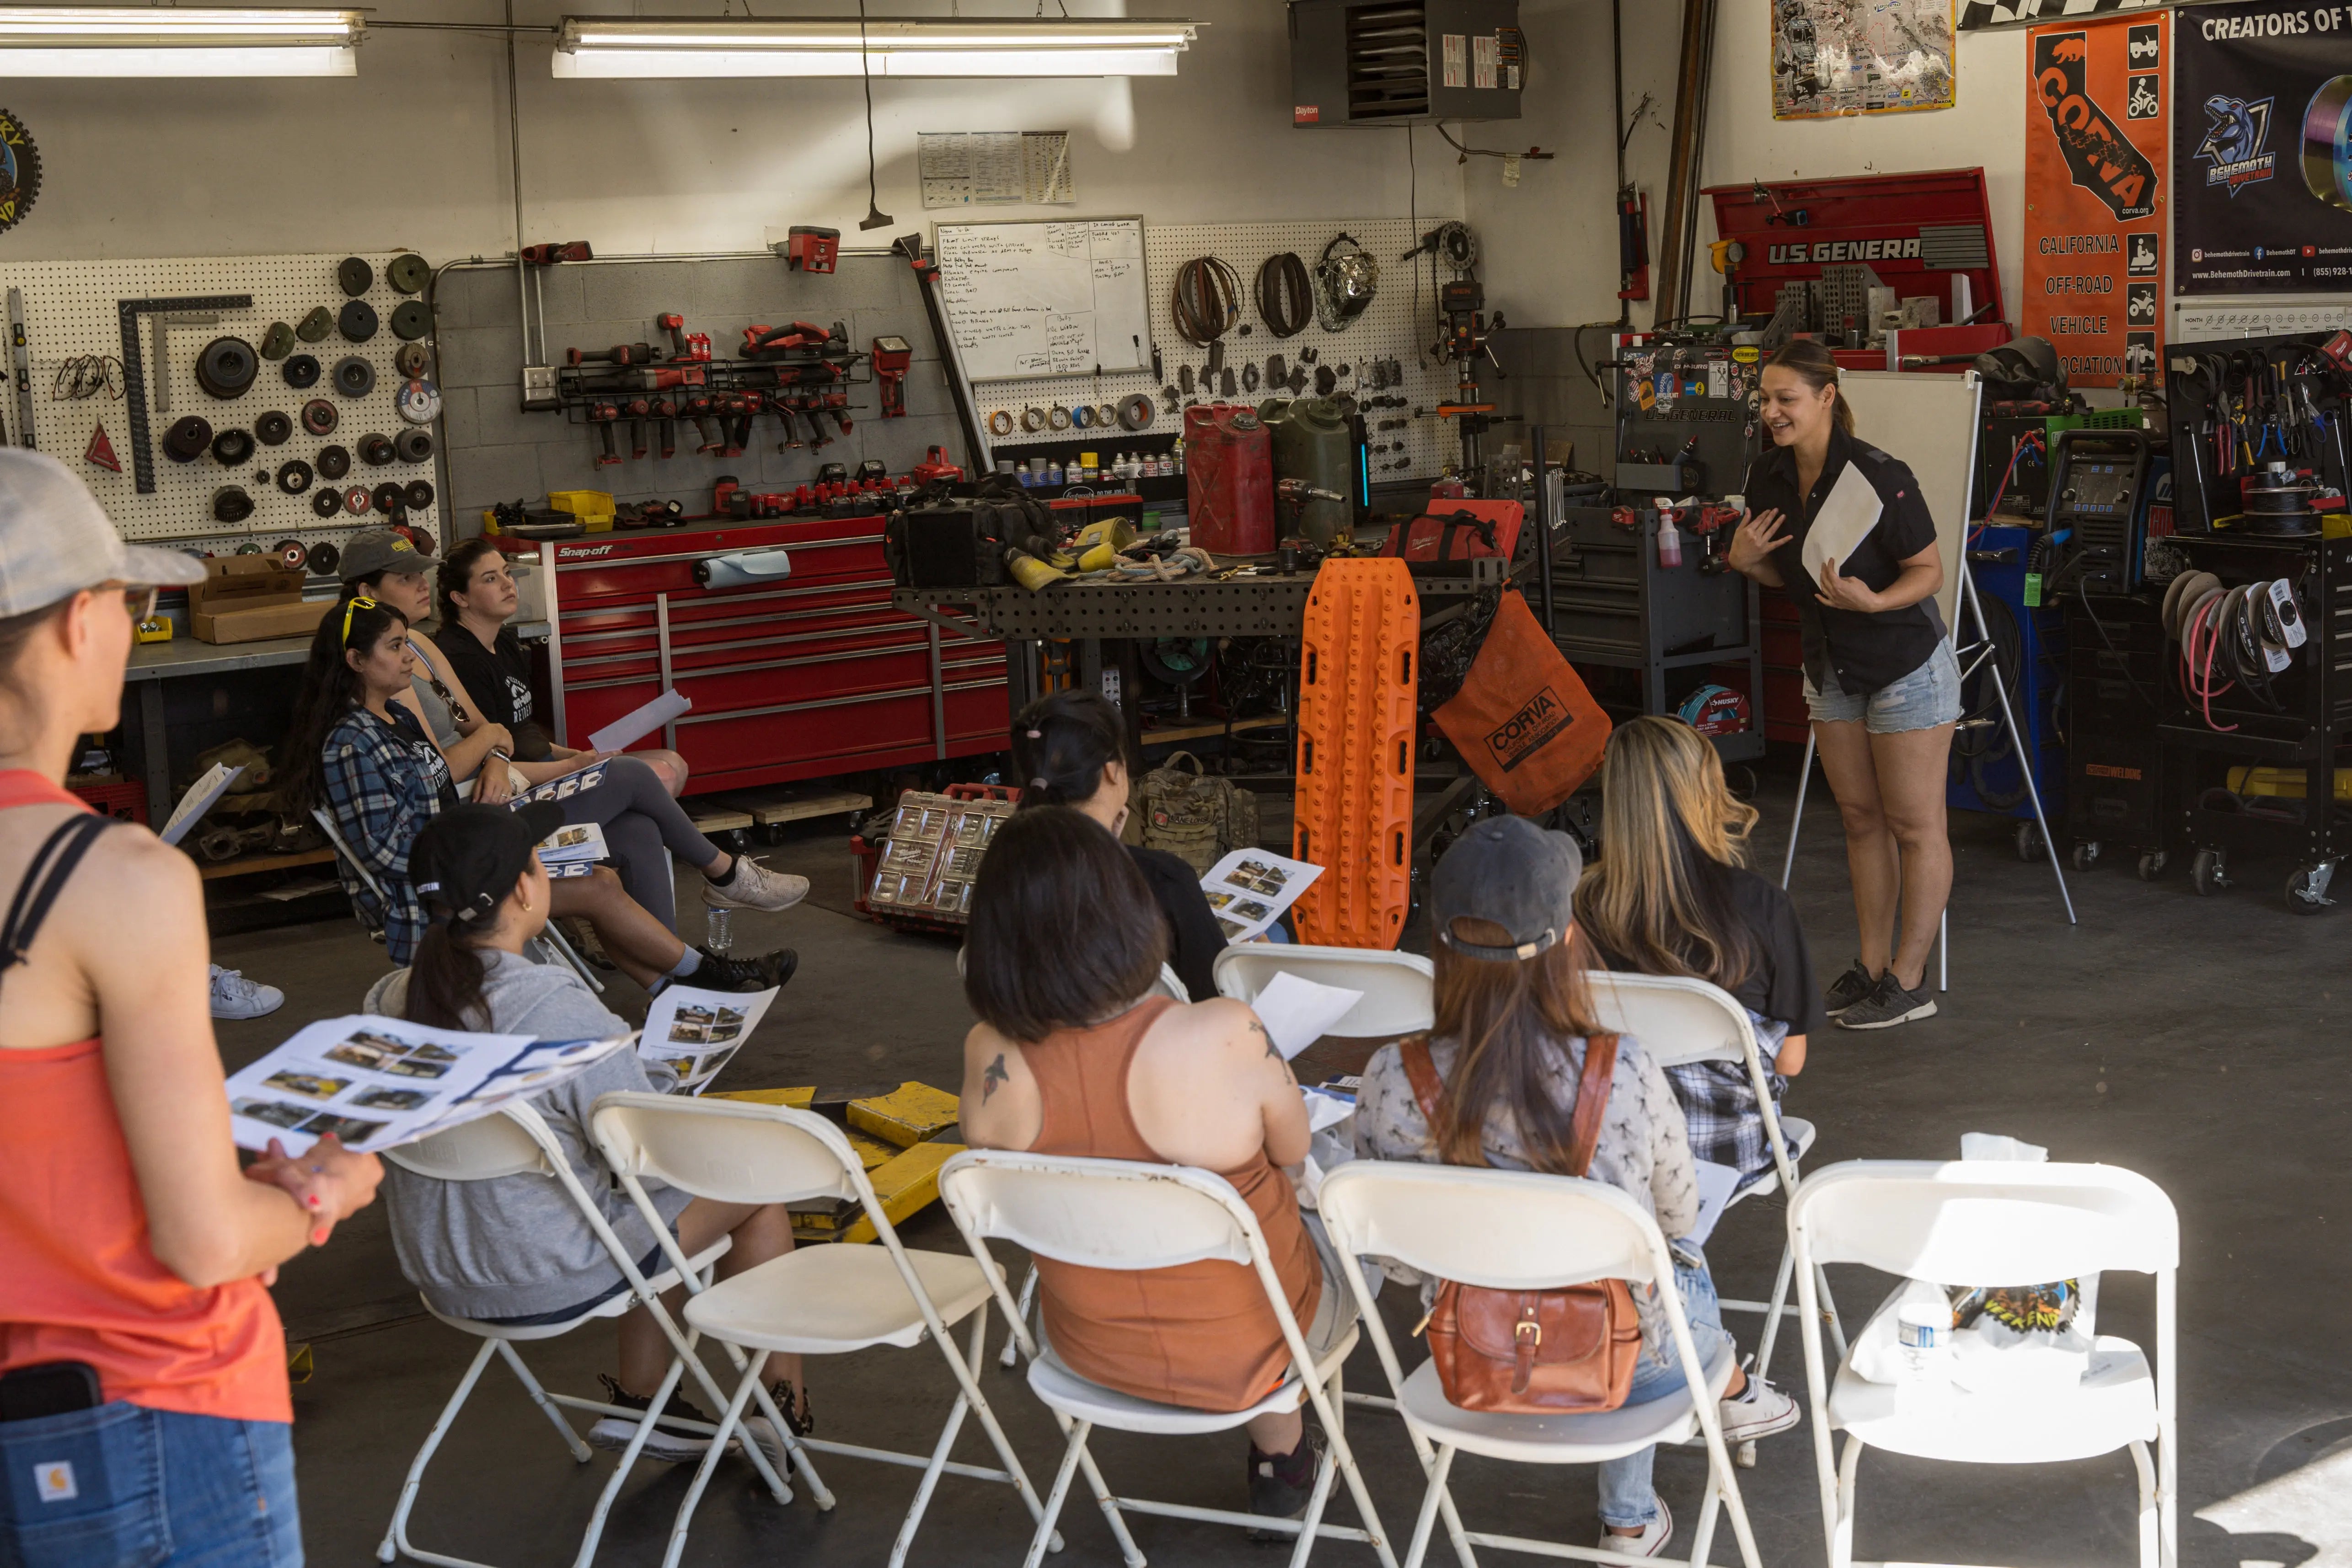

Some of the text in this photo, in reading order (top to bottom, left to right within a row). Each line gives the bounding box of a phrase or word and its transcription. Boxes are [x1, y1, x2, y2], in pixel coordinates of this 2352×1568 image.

[2202, 11, 2309, 41] CREATORS
[2314, 8, 2342, 32] OF
[1295, 106, 1318, 115] Dayton
[2210, 155, 2272, 182] BEHEMOTH
[2229, 168, 2272, 185] DRIVETRAIN
[1811, 237, 1923, 263] GENERA
[2039, 234, 2119, 255] CALIFORNIA
[2192, 269, 2290, 279] www.BehemothDrivetrain.com
[2314, 268, 2331, 277] (855)
[2046, 276, 2113, 295] OFF-ROAD
[2050, 316, 2108, 335] VEHICLE
[2060, 355, 2122, 375] OCIATION
[1669, 408, 1737, 423] GENERAL
[558, 545, 613, 558] Snap-off
[1493, 696, 1556, 750] CORVA
[1528, 716, 1559, 744] ASSOCIATION
[2110, 766, 2142, 781] WELDING
